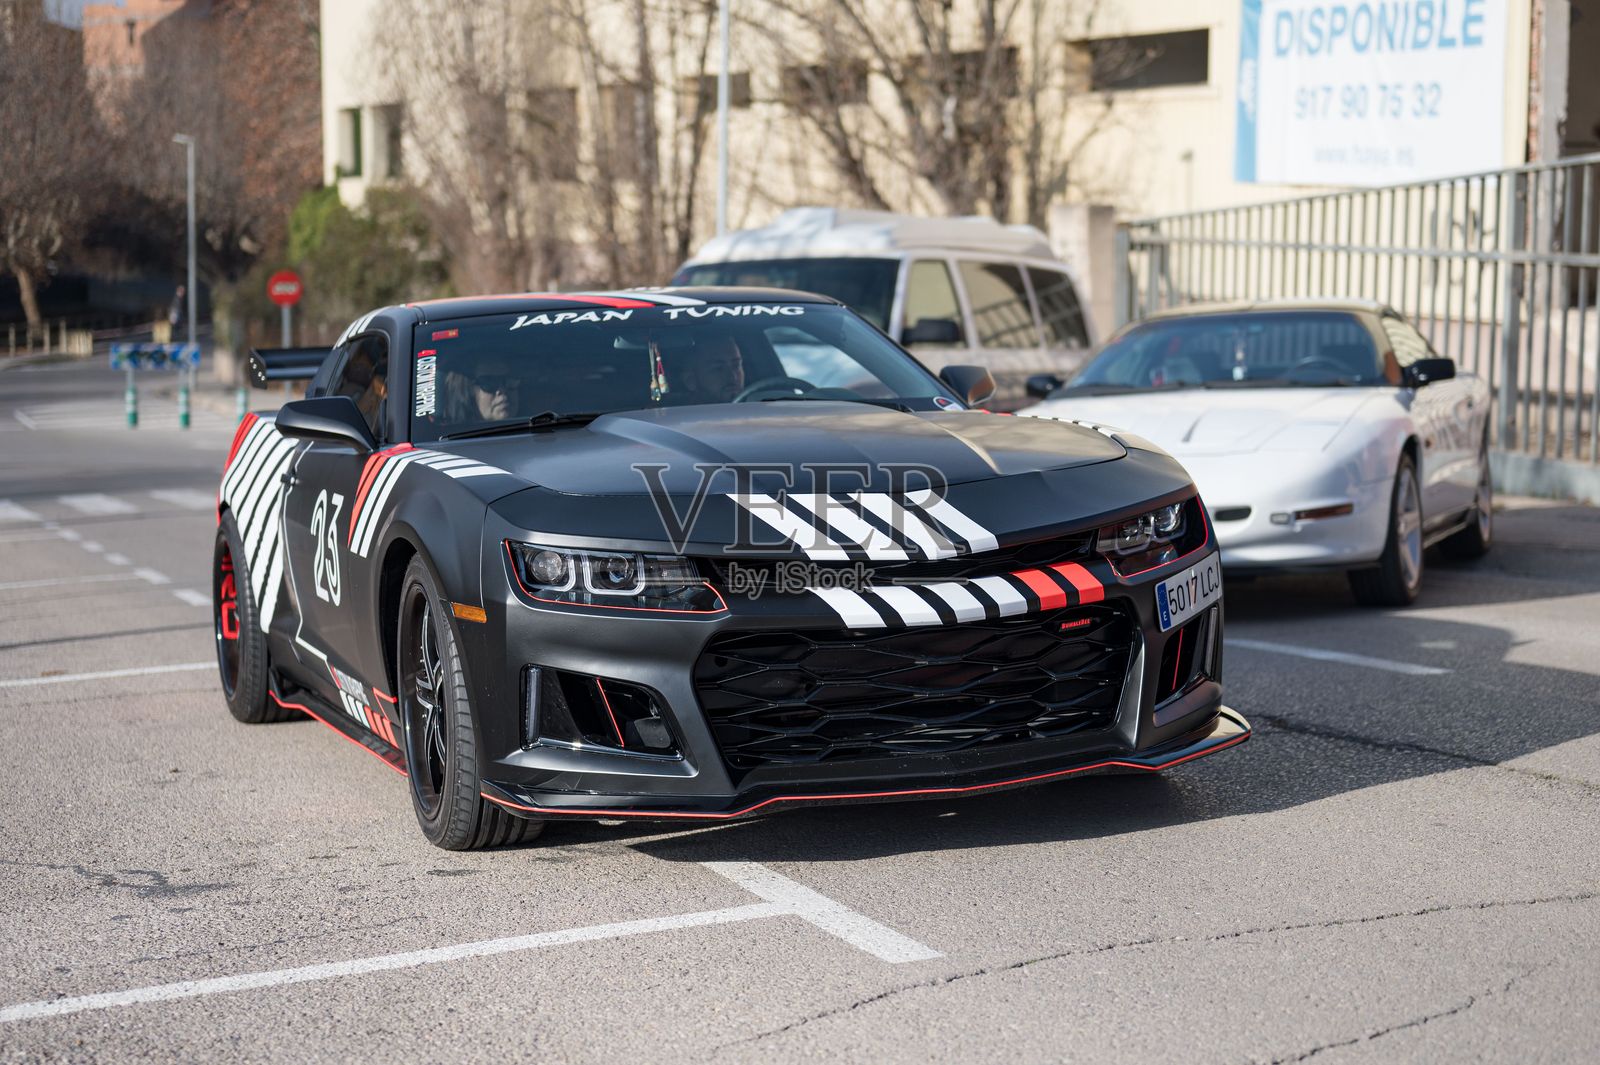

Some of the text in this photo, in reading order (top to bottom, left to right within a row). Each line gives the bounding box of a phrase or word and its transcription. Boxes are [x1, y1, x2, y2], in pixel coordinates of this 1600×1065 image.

[1274, 0, 1486, 56] DISPONIBLE
[1295, 85, 1333, 119] 917
[1341, 84, 1369, 118] 90
[1378, 82, 1403, 118] 75
[1412, 81, 1442, 118] 32
[509, 304, 805, 331] JAPAN TUNING
[310, 489, 345, 607] 23
[1168, 560, 1220, 616] 5017 LCJ
